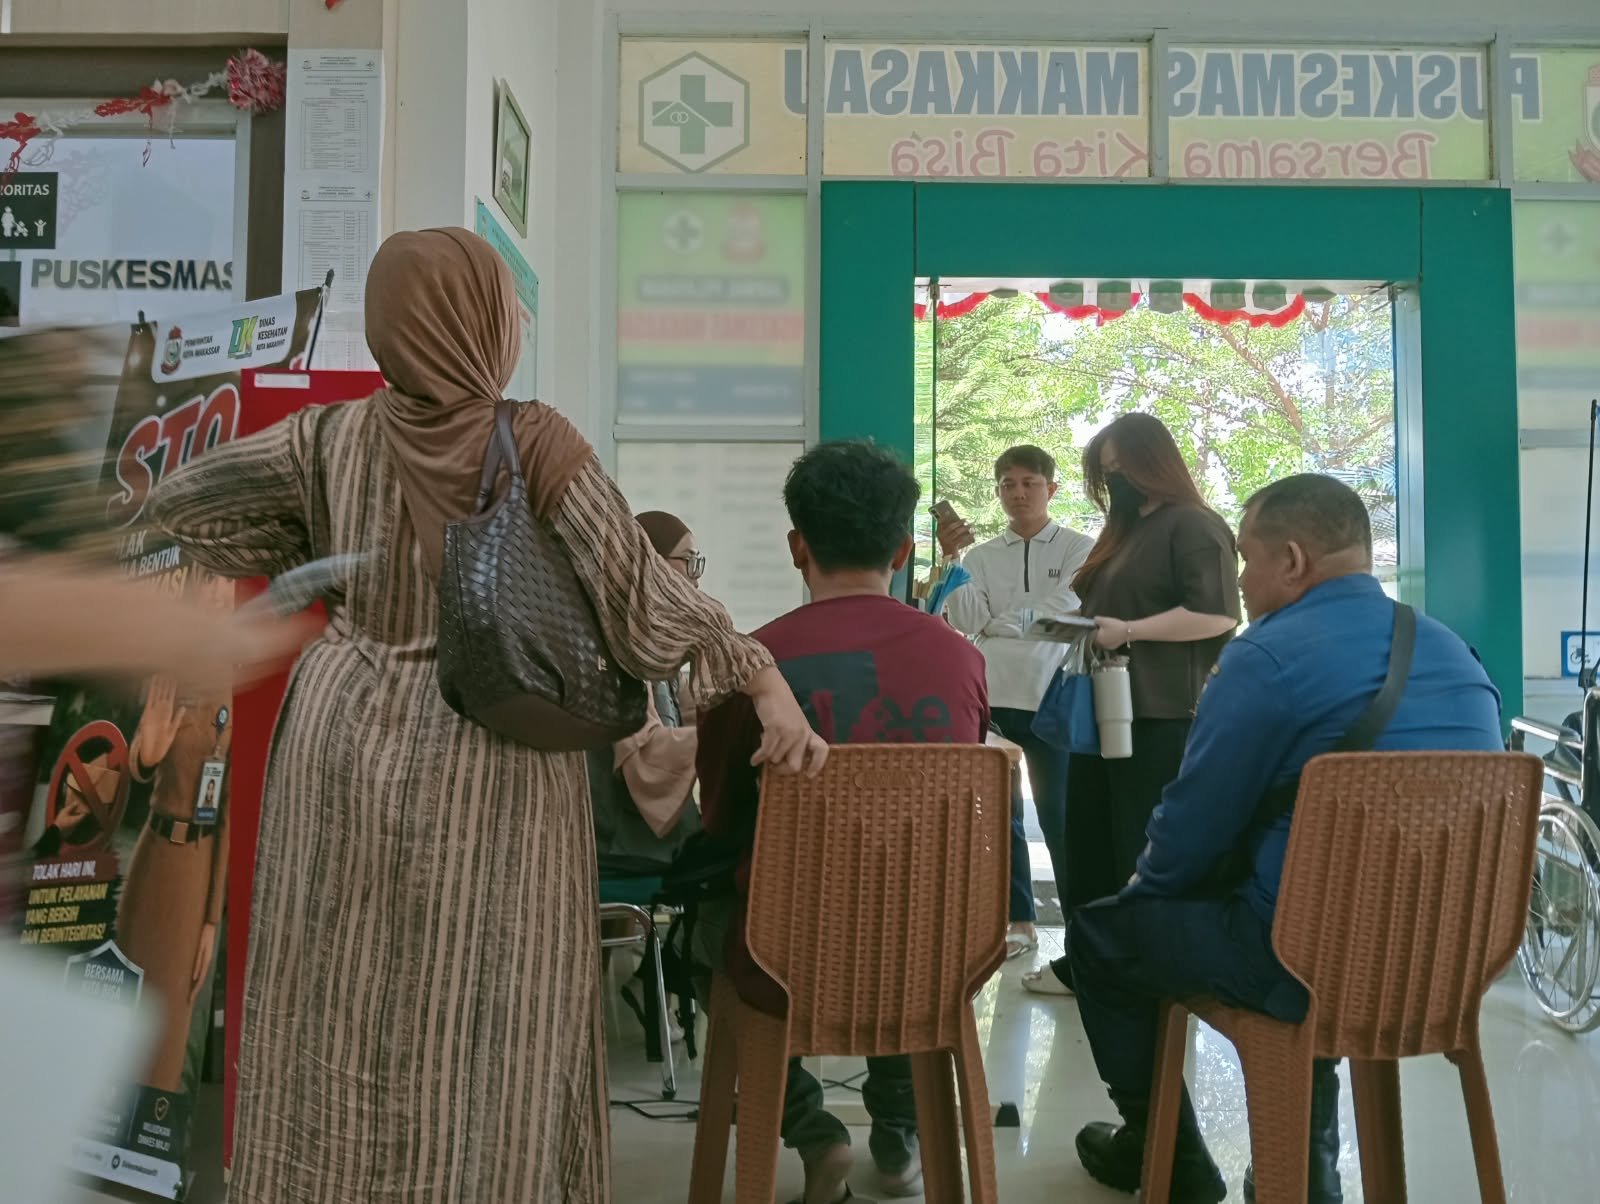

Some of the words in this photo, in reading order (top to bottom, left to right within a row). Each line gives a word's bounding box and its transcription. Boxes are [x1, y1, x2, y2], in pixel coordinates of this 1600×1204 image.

[259, 317, 276, 328] DINAS
[257, 327, 288, 340] KESEHATAN
[138, 544, 181, 576] BENTUK
[84, 963, 124, 985] BERSAMA
